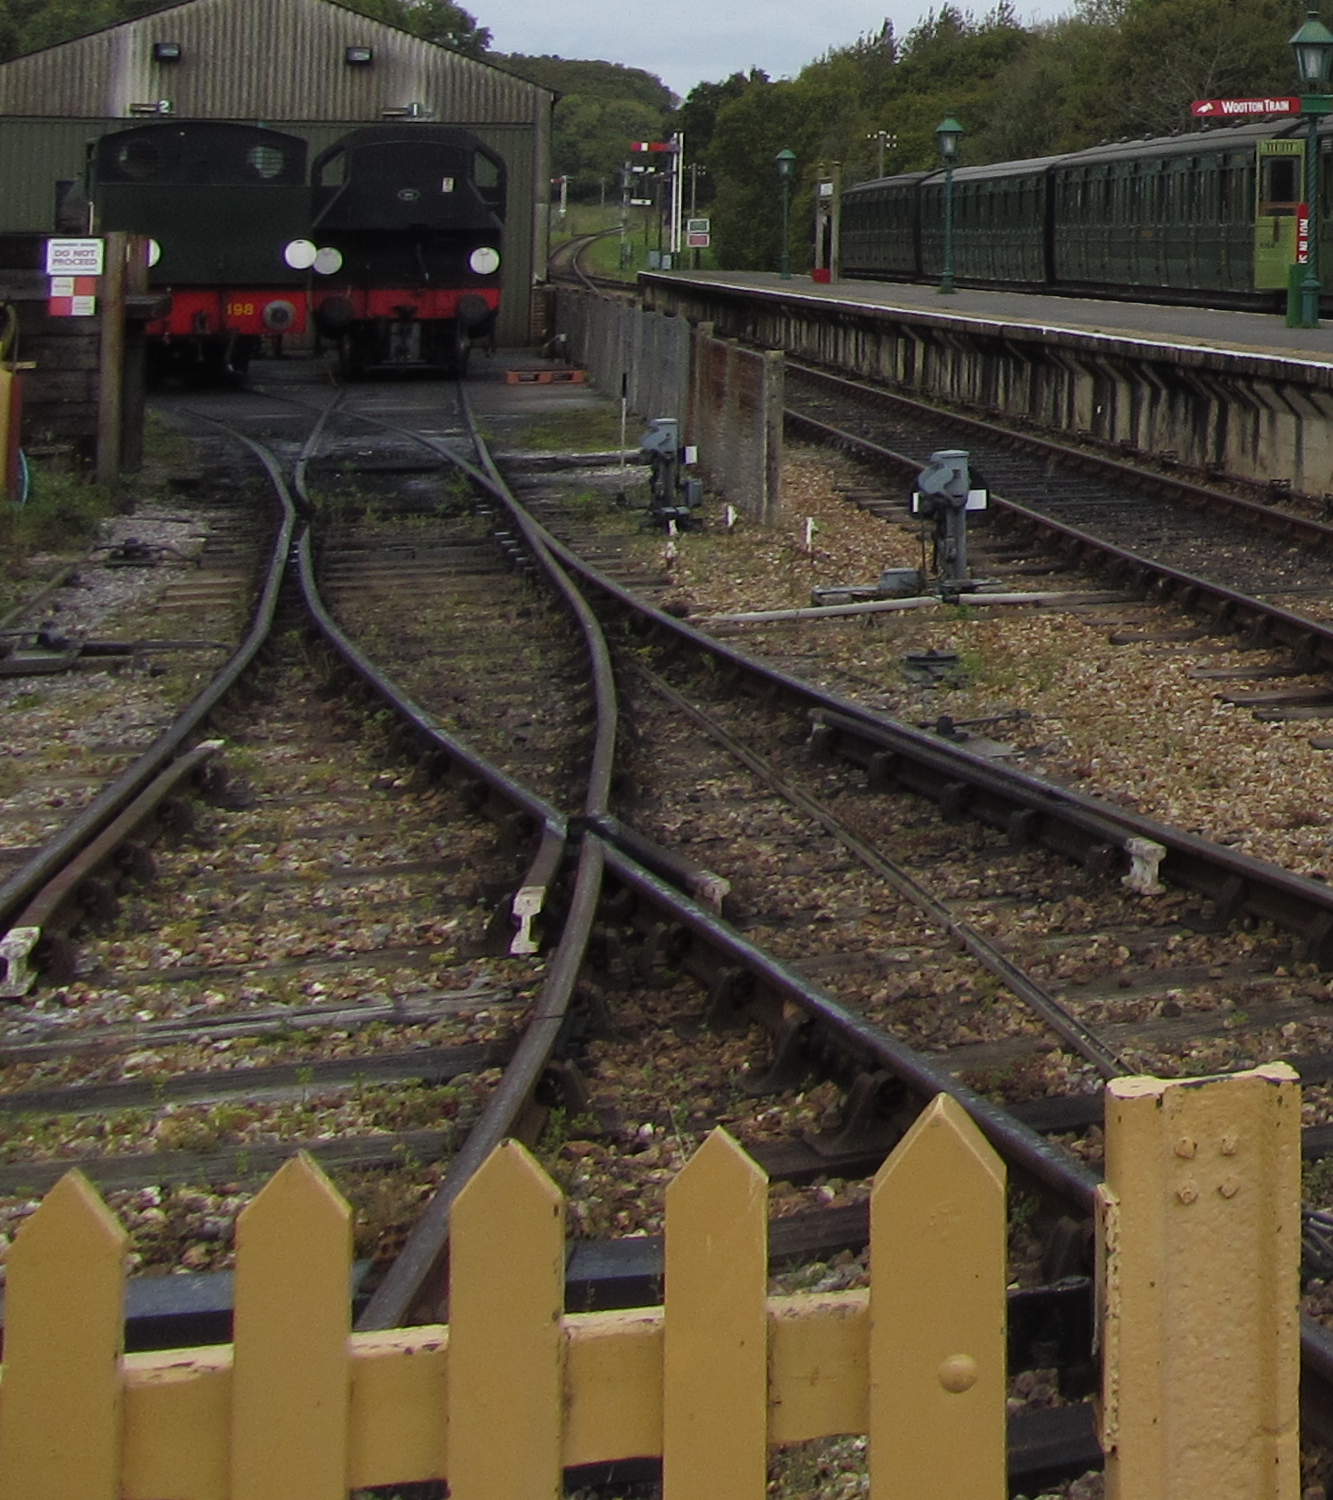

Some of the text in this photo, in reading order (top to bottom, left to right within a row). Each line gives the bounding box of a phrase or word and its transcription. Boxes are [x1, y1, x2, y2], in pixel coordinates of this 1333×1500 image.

[159, 99, 169, 113] 2
[1221, 99, 1290, 114] WOOTTON TRAIN
[52, 258, 98, 266] PROCEED
[226, 303, 254, 316] 198
